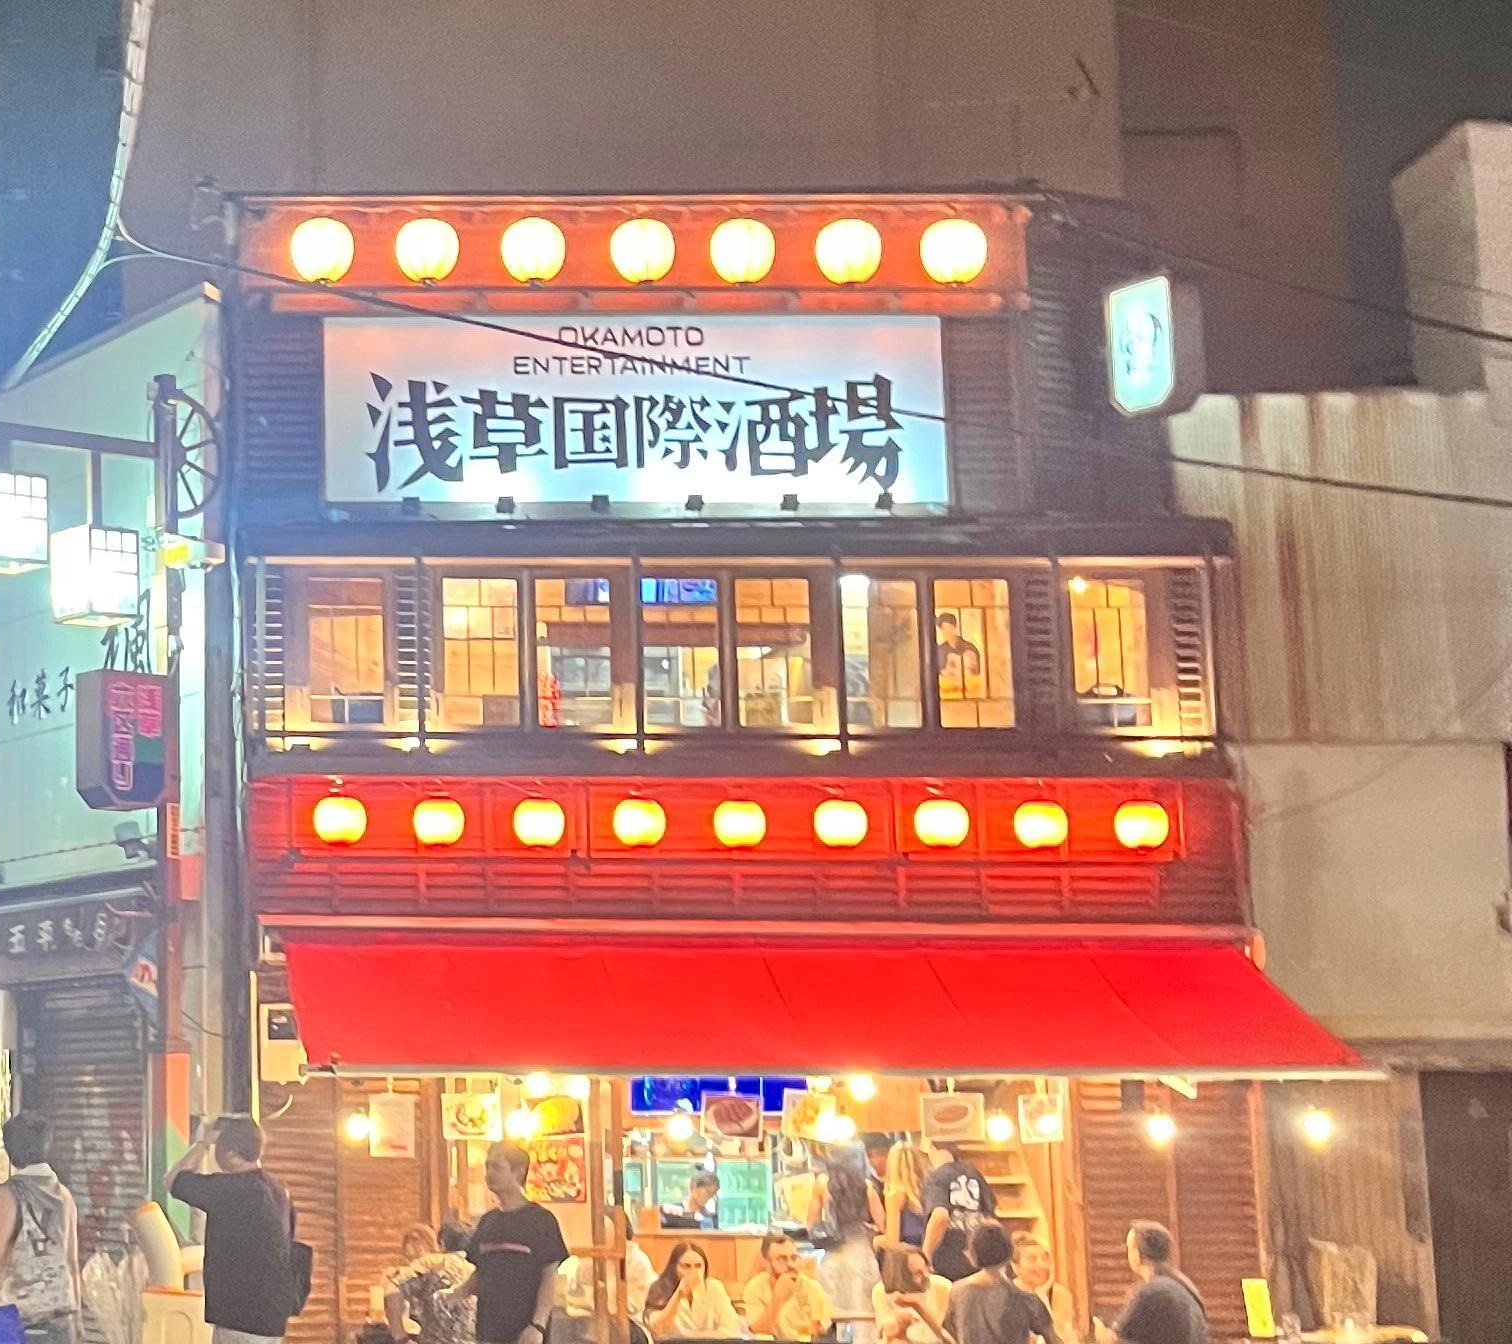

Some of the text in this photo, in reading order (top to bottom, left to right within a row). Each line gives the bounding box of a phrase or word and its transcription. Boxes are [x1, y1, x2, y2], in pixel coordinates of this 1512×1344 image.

[558, 326, 704, 347] OKAMOTO
[513, 355, 751, 375] ENTERTAINMENT
[366, 372, 904, 492] 浅草国際酒場
[7, 666, 74, 718] 和菓子
